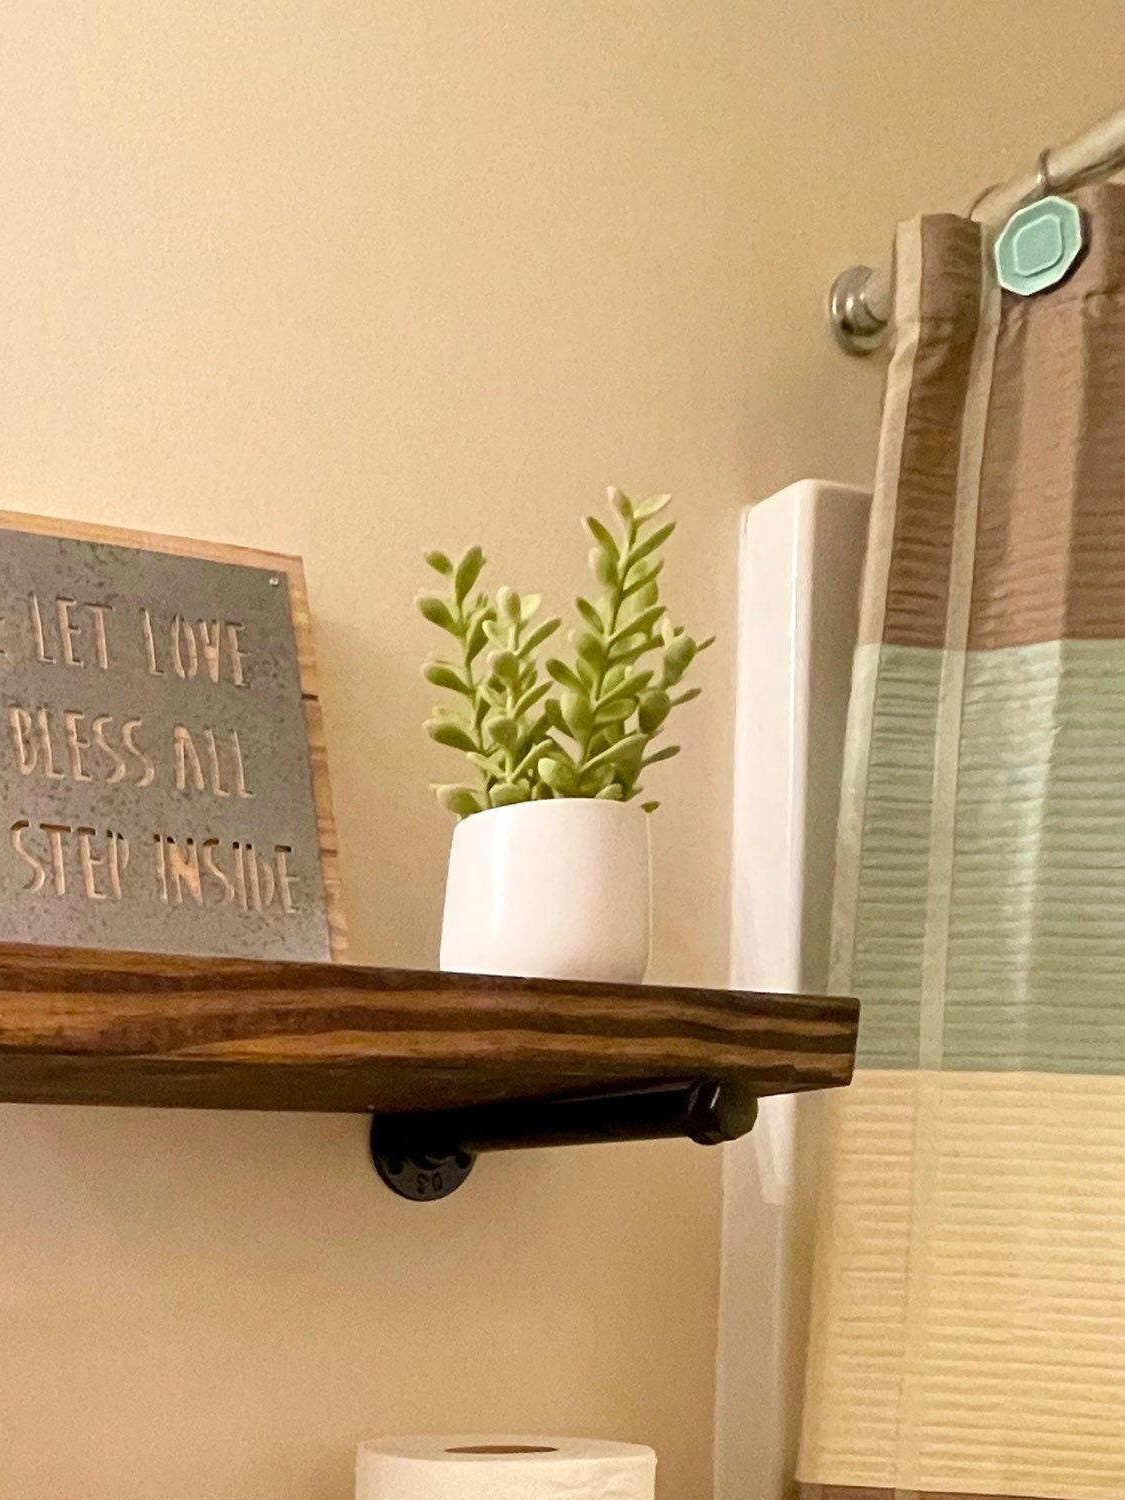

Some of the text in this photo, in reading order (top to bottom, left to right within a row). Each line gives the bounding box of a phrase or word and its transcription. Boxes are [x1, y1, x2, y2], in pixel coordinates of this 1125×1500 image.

[29, 592, 113, 670] LET
[140, 608, 252, 688] LOVE
[9, 703, 156, 788] BLESS
[175, 723, 254, 799] ALL
[10, 820, 130, 900] STEP
[153, 833, 302, 915] INSIDE
